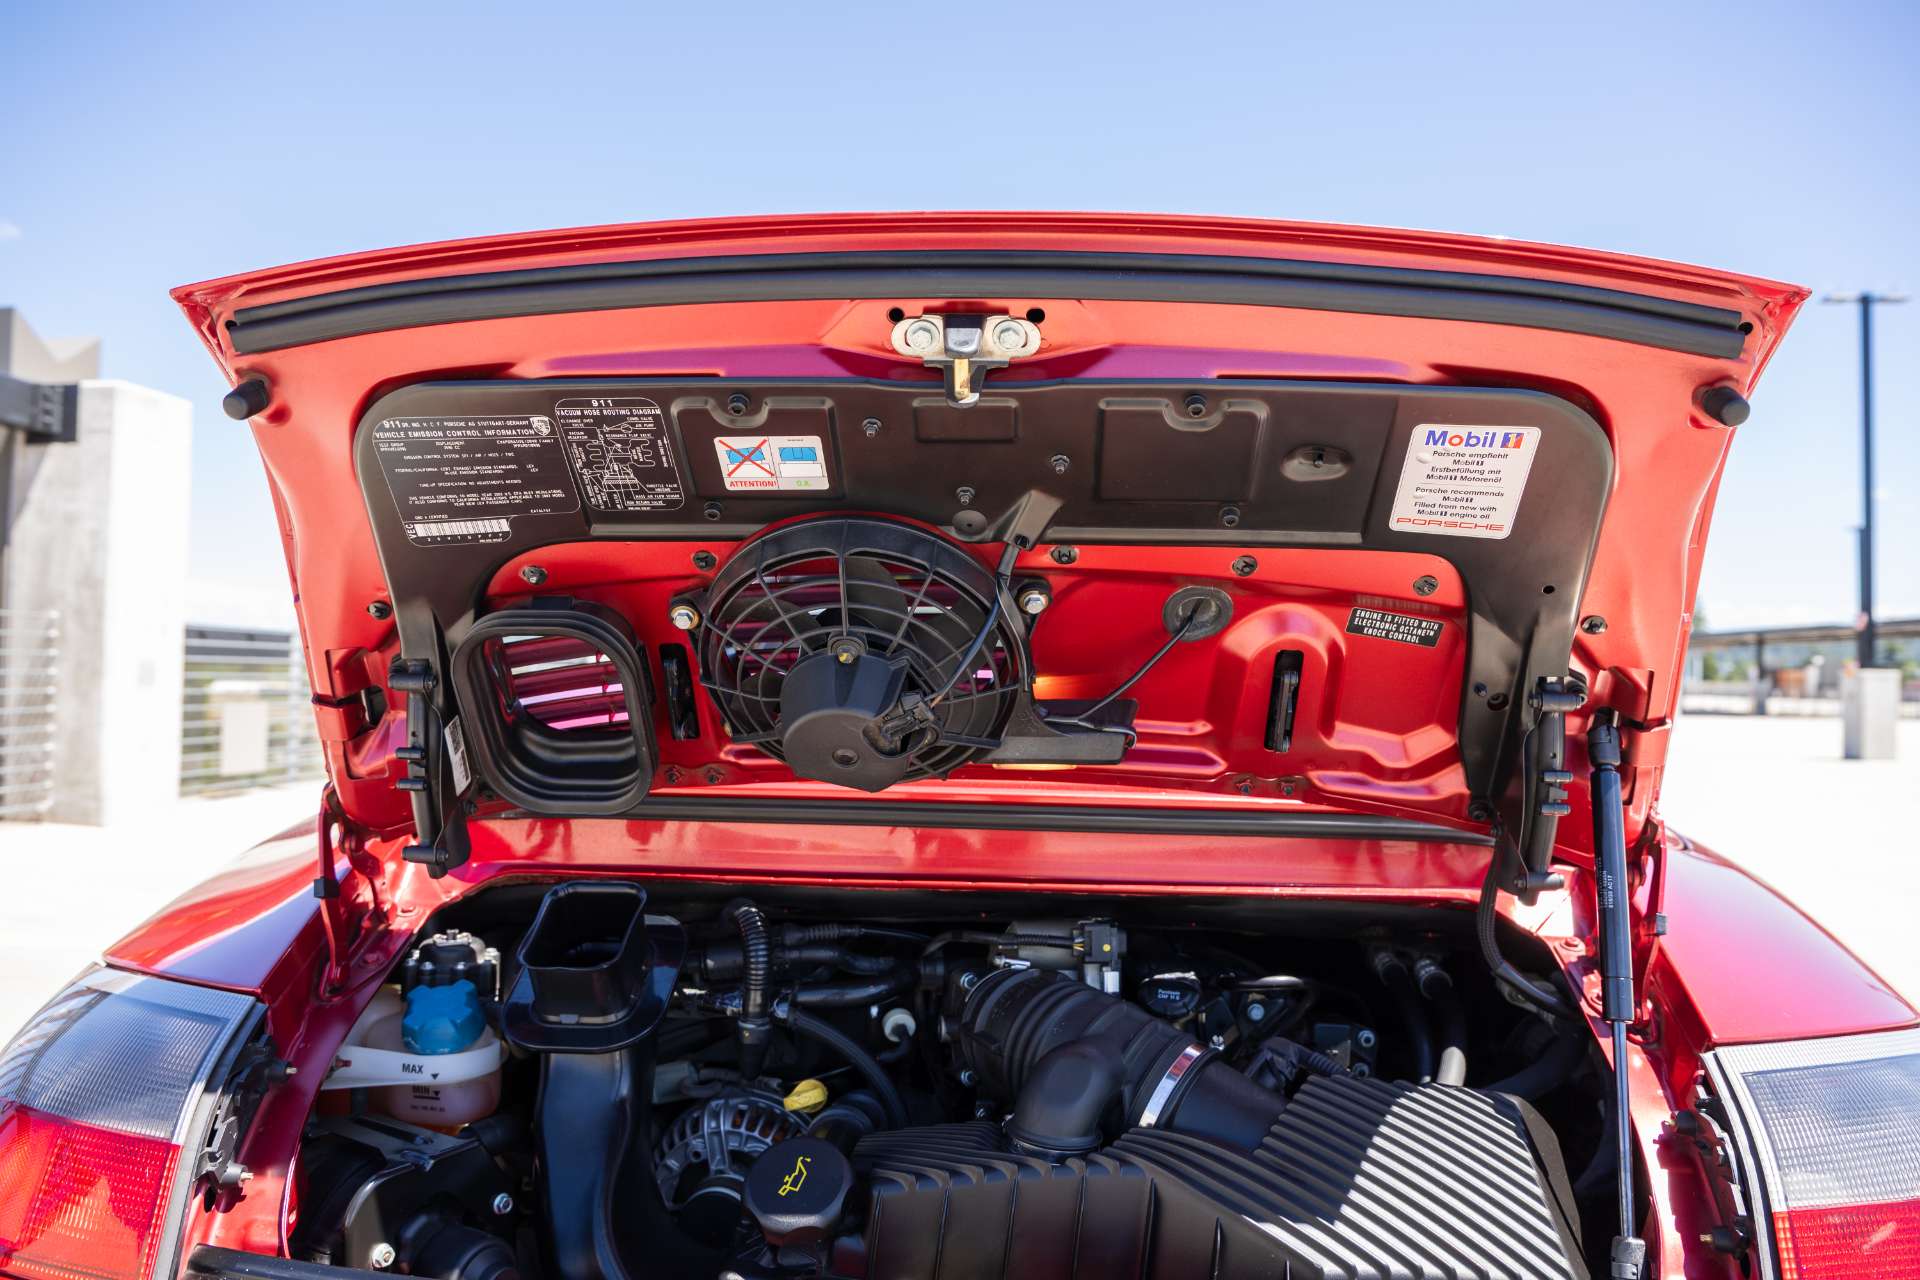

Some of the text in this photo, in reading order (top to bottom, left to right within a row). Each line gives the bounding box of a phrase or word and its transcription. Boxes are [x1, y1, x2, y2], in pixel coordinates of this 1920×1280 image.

[1425, 430, 1496, 448] Mobil
[1431, 466, 1485, 475] Erstbefüllung
[1450, 489, 1504, 497] recommends
[406, 524, 416, 538] VEC
[1396, 517, 1504, 531] PORSCHE
[1354, 617, 1397, 631] ELECTRONIC
[1356, 610, 1382, 620] ENGINE
[1394, 616, 1419, 627] FITTED
[1421, 621, 1439, 630] WITH
[1363, 627, 1419, 643] KNOCK CONTROL
[402, 1063, 424, 1074] MAX
[412, 1085, 430, 1094] MIN
